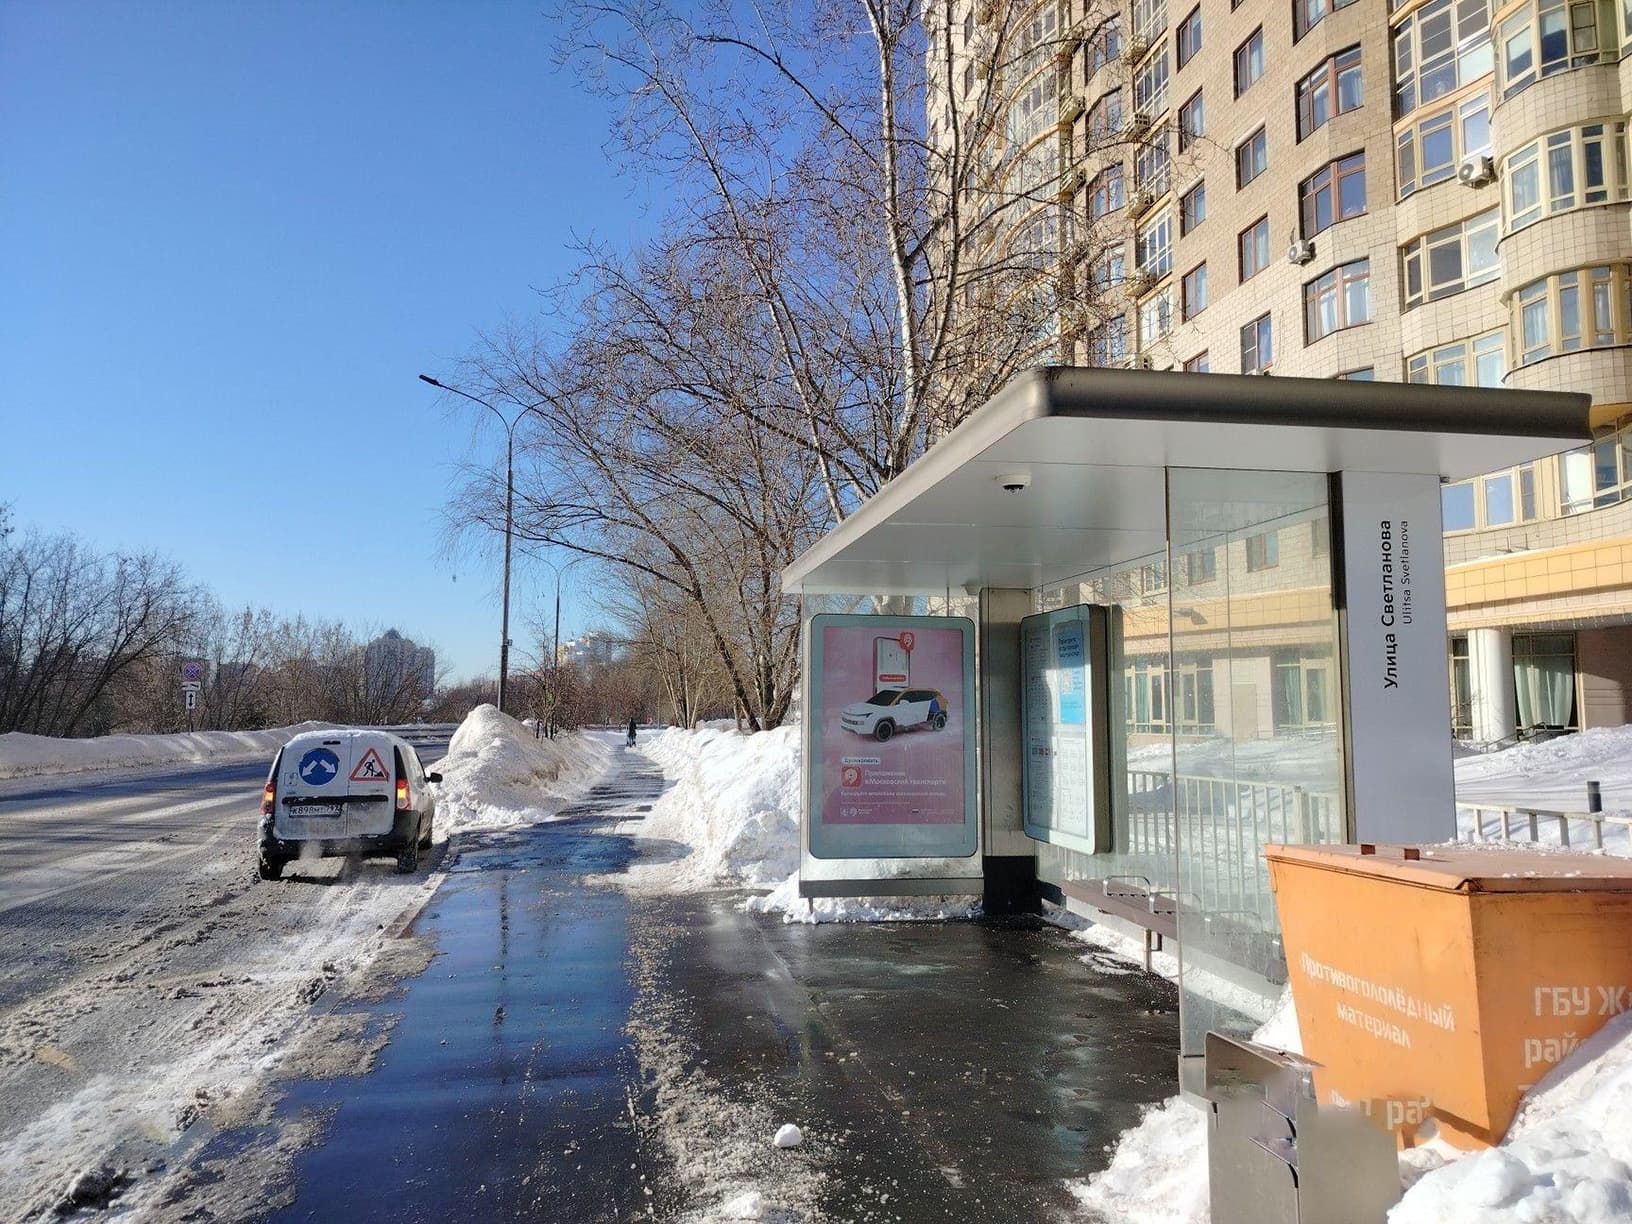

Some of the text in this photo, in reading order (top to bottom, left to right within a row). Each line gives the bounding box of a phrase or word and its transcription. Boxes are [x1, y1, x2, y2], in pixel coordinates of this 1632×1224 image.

[1380, 520, 1398, 689] Улица Светланова
[1399, 520, 1412, 625] Ulitsa Svetlanova
[1301, 951, 1456, 1032] Противогололёдный
[1337, 1001, 1412, 1049] материал
[1535, 986, 1632, 1017] ГБУ Ж
